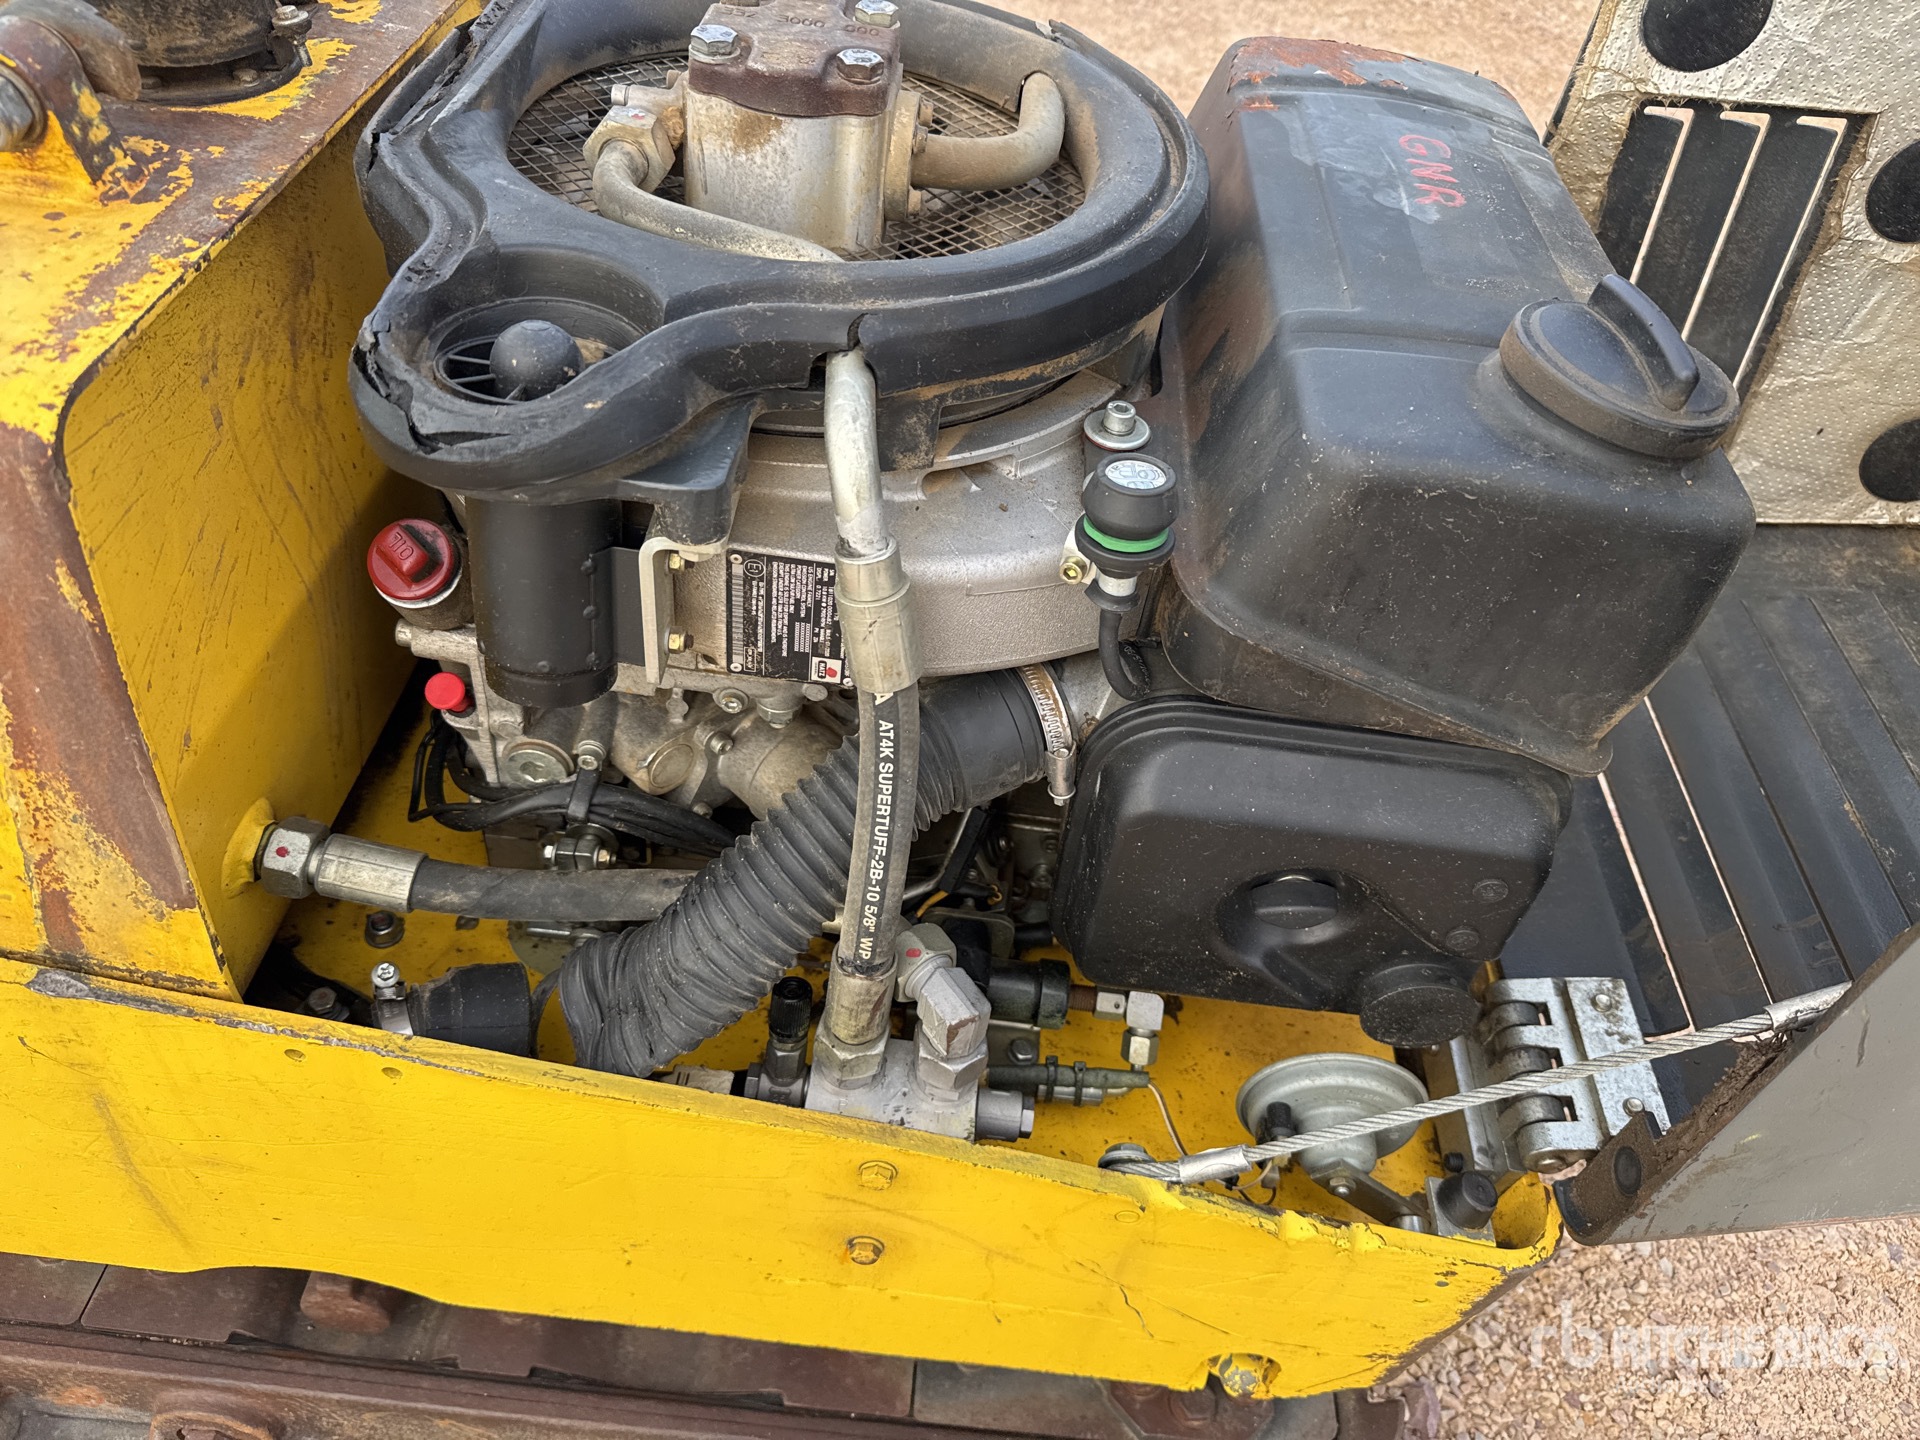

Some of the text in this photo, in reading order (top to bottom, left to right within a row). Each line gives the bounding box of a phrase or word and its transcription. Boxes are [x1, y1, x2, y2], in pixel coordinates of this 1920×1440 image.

[388, 531, 415, 561] OIL
[858, 720, 894, 960] AT4K SUPERTUFF-2B-10 5/8" WP
